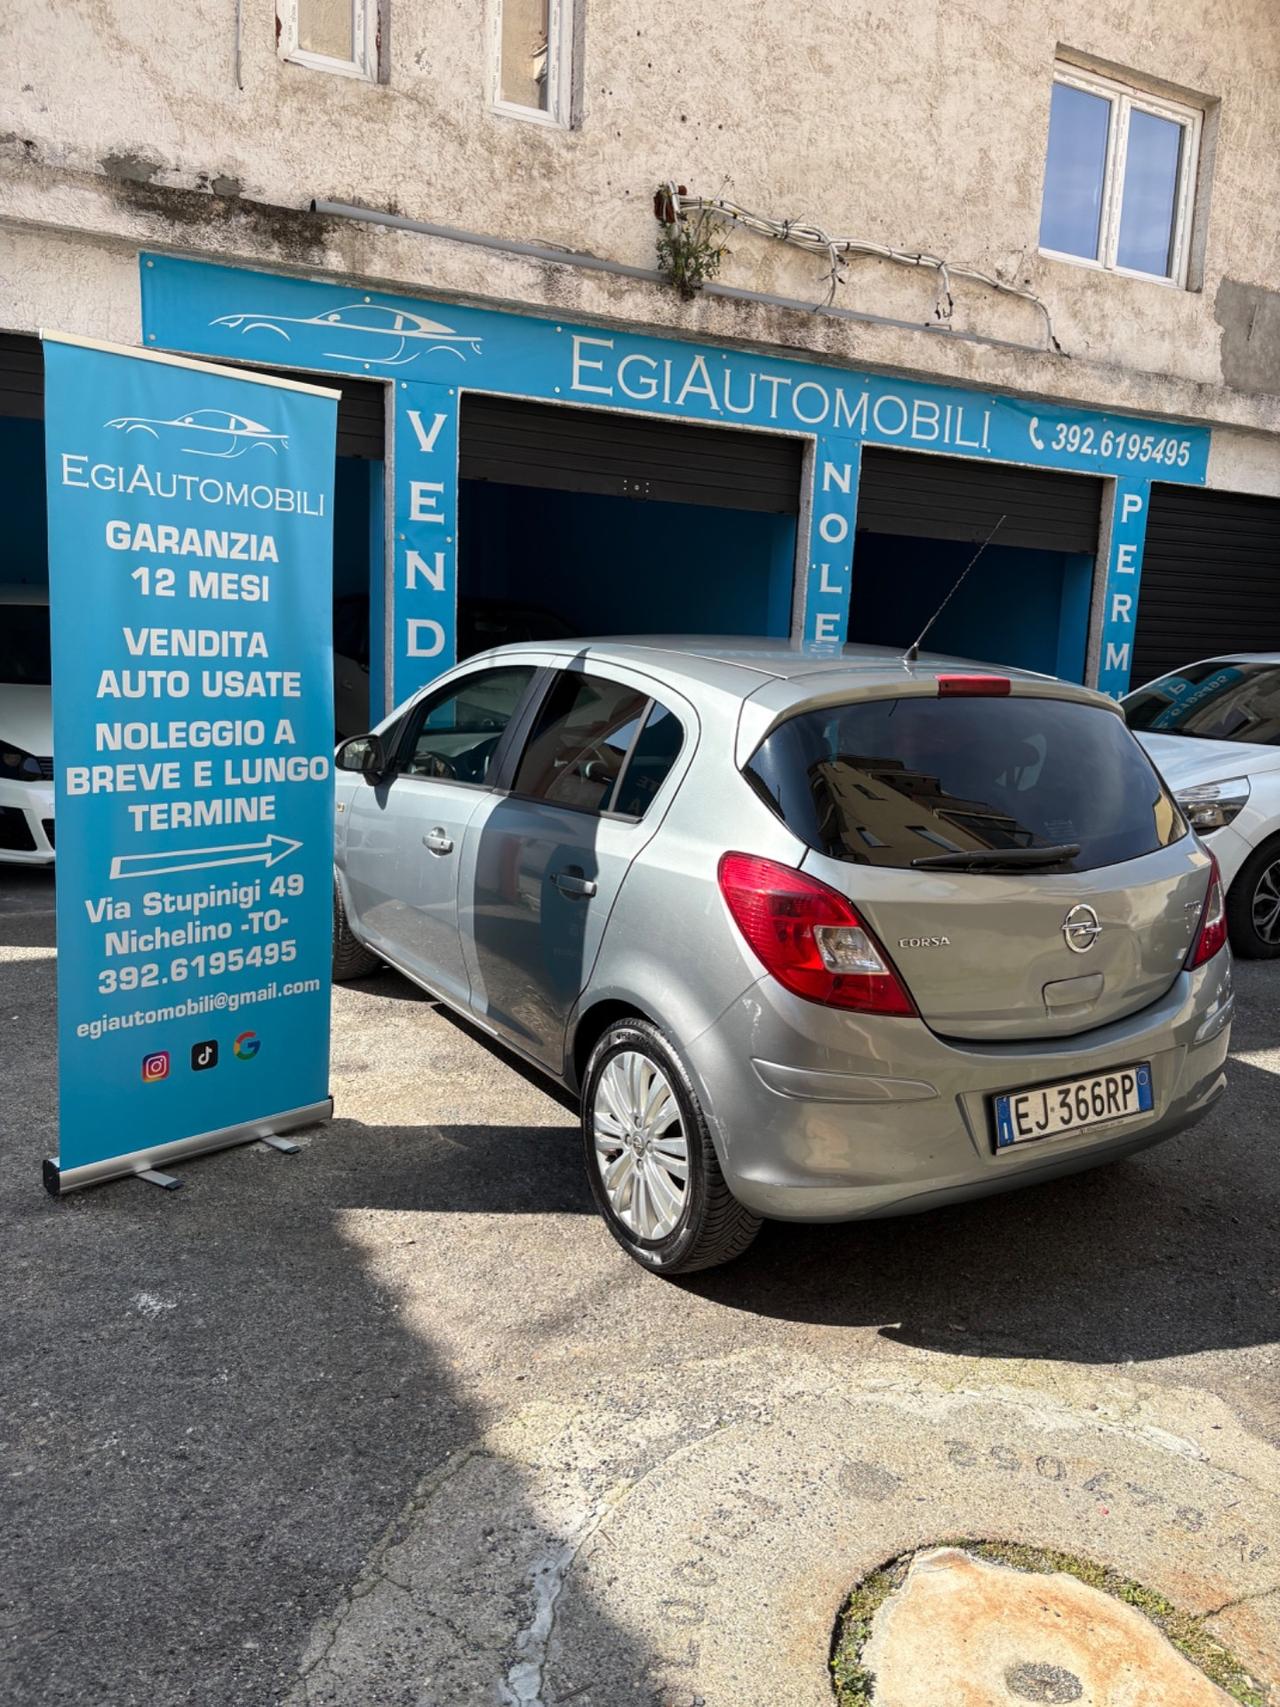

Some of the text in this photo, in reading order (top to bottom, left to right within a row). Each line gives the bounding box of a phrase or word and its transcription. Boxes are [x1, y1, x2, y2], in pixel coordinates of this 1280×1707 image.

[1051, 422, 1191, 467] 392.6195495
[105, 520, 279, 563] GARANZIA
[404, 410, 448, 691] VEND
[131, 567, 269, 602] 12 MESI
[122, 627, 269, 658] VENDITA
[96, 670, 301, 698] AUTO USATE
[96, 719, 296, 751] NOLEGGIO A
[66, 756, 329, 796] BREVE E LUNGO
[128, 795, 276, 832] TERMINE
[84, 874, 305, 923] Via Stupinigi 49
[105, 909, 289, 956] Nichelino -TO-
[898, 936, 951, 948] CORSA
[98, 940, 297, 994] 392.6195495
[76, 979, 321, 1040] egiautomobili@gmail.com
